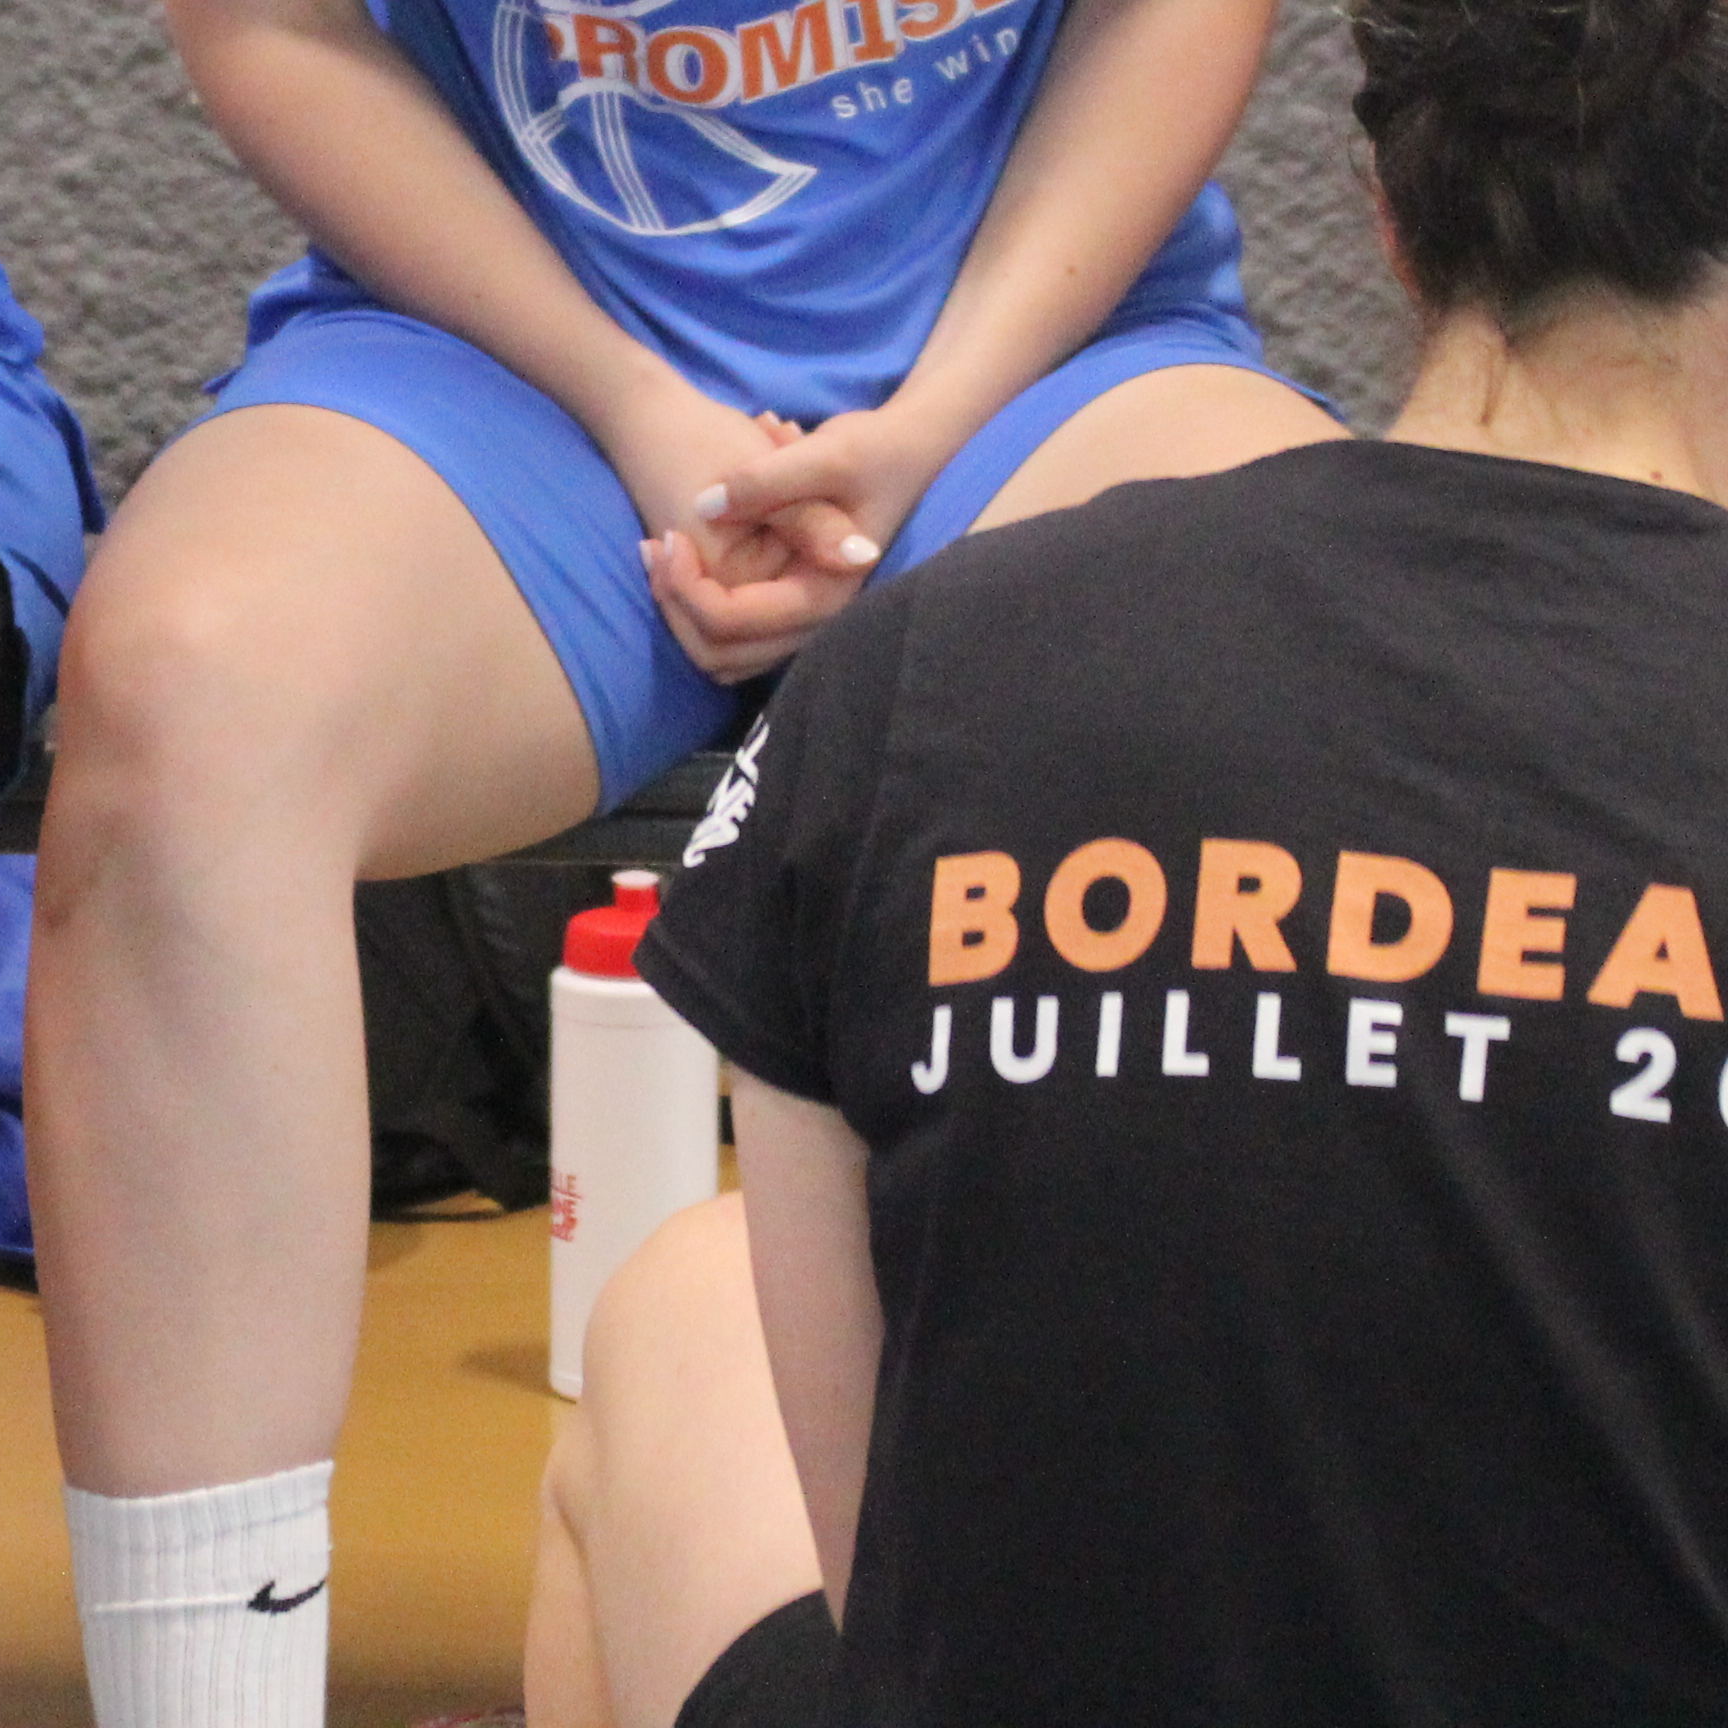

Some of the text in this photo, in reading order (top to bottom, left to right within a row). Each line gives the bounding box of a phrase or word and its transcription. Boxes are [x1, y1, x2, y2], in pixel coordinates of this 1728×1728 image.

[831, 28, 1018, 118] she win
[911, 989, 1510, 1102] JUILLET
